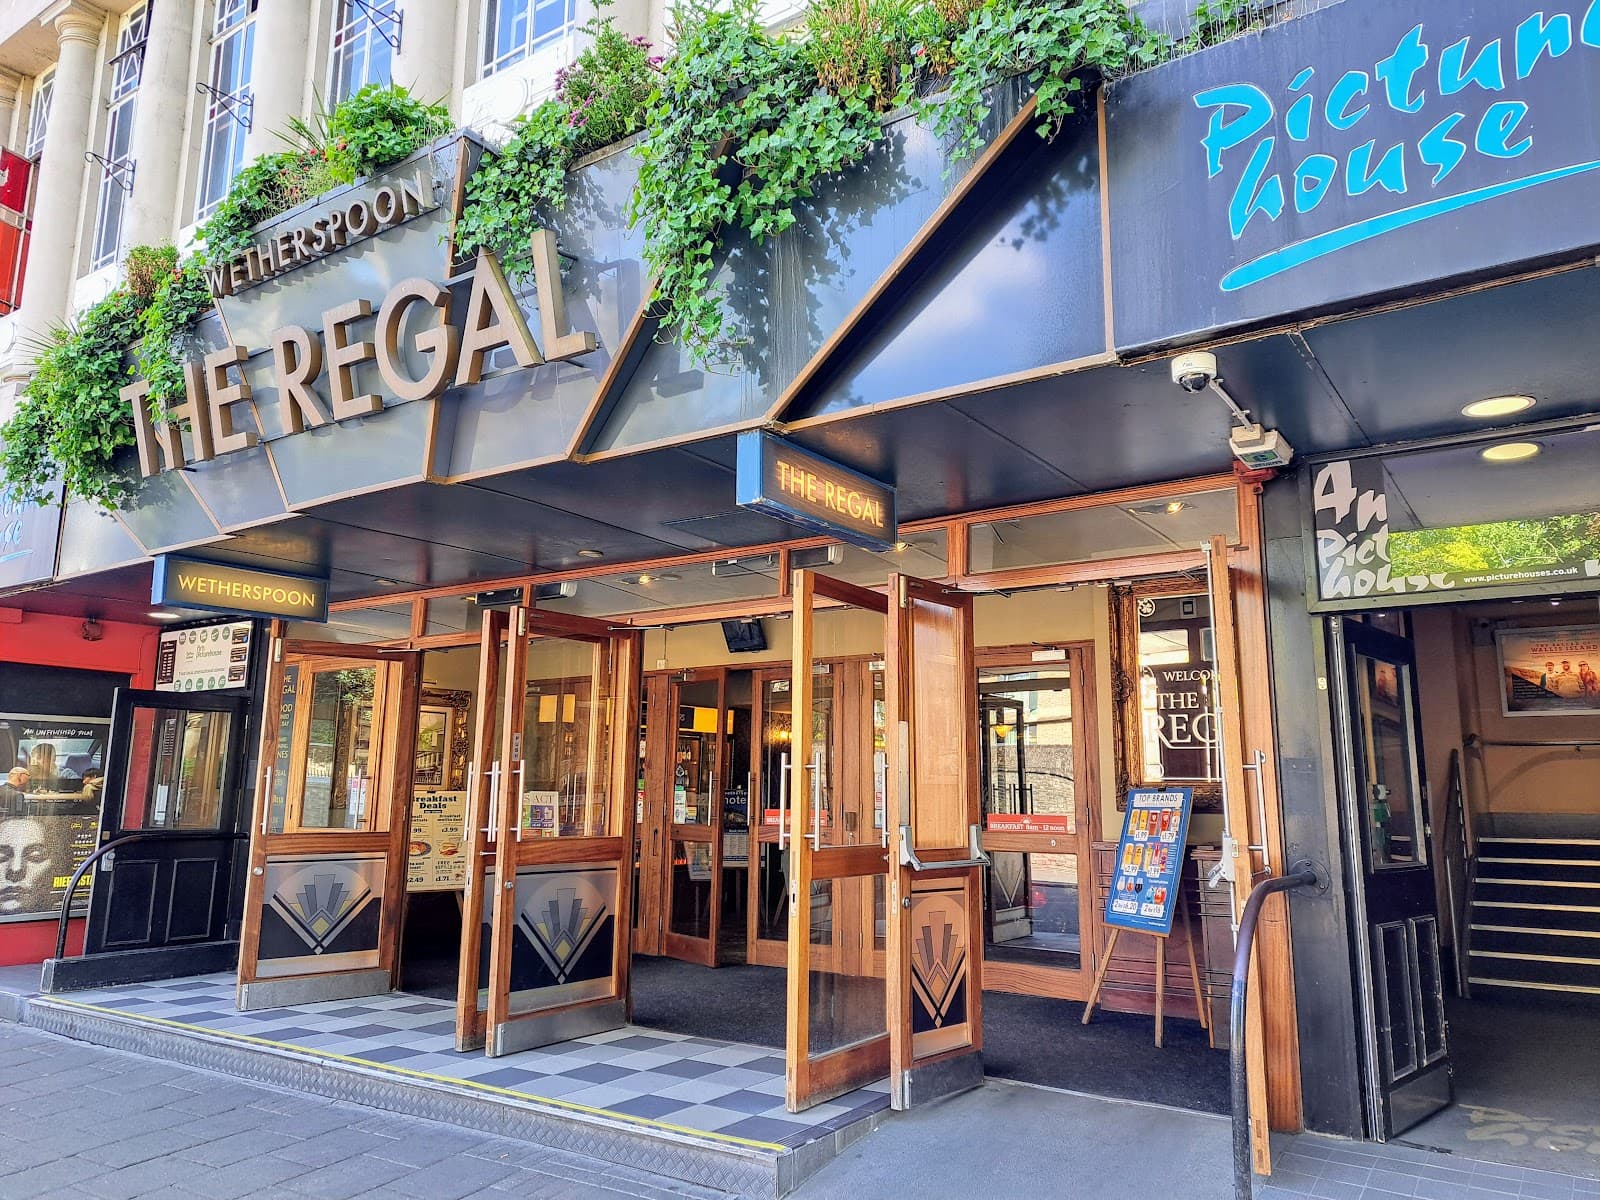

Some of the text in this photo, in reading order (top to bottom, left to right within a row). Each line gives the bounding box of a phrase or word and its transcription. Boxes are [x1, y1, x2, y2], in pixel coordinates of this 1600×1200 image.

[1228, 100, 1534, 240] house
[203, 171, 438, 299] WETHERSPOON
[118, 228, 597, 479] THE REGAL
[777, 460, 884, 529] THE REGAL
[177, 574, 316, 608] WETHERSPOON
[1463, 566, 1579, 583] www.picturehouses.co.uk
[1157, 692, 1200, 710] THE
[1139, 794, 1178, 802] TOP BRANDS
[989, 823, 1024, 831] BREAKFAST
